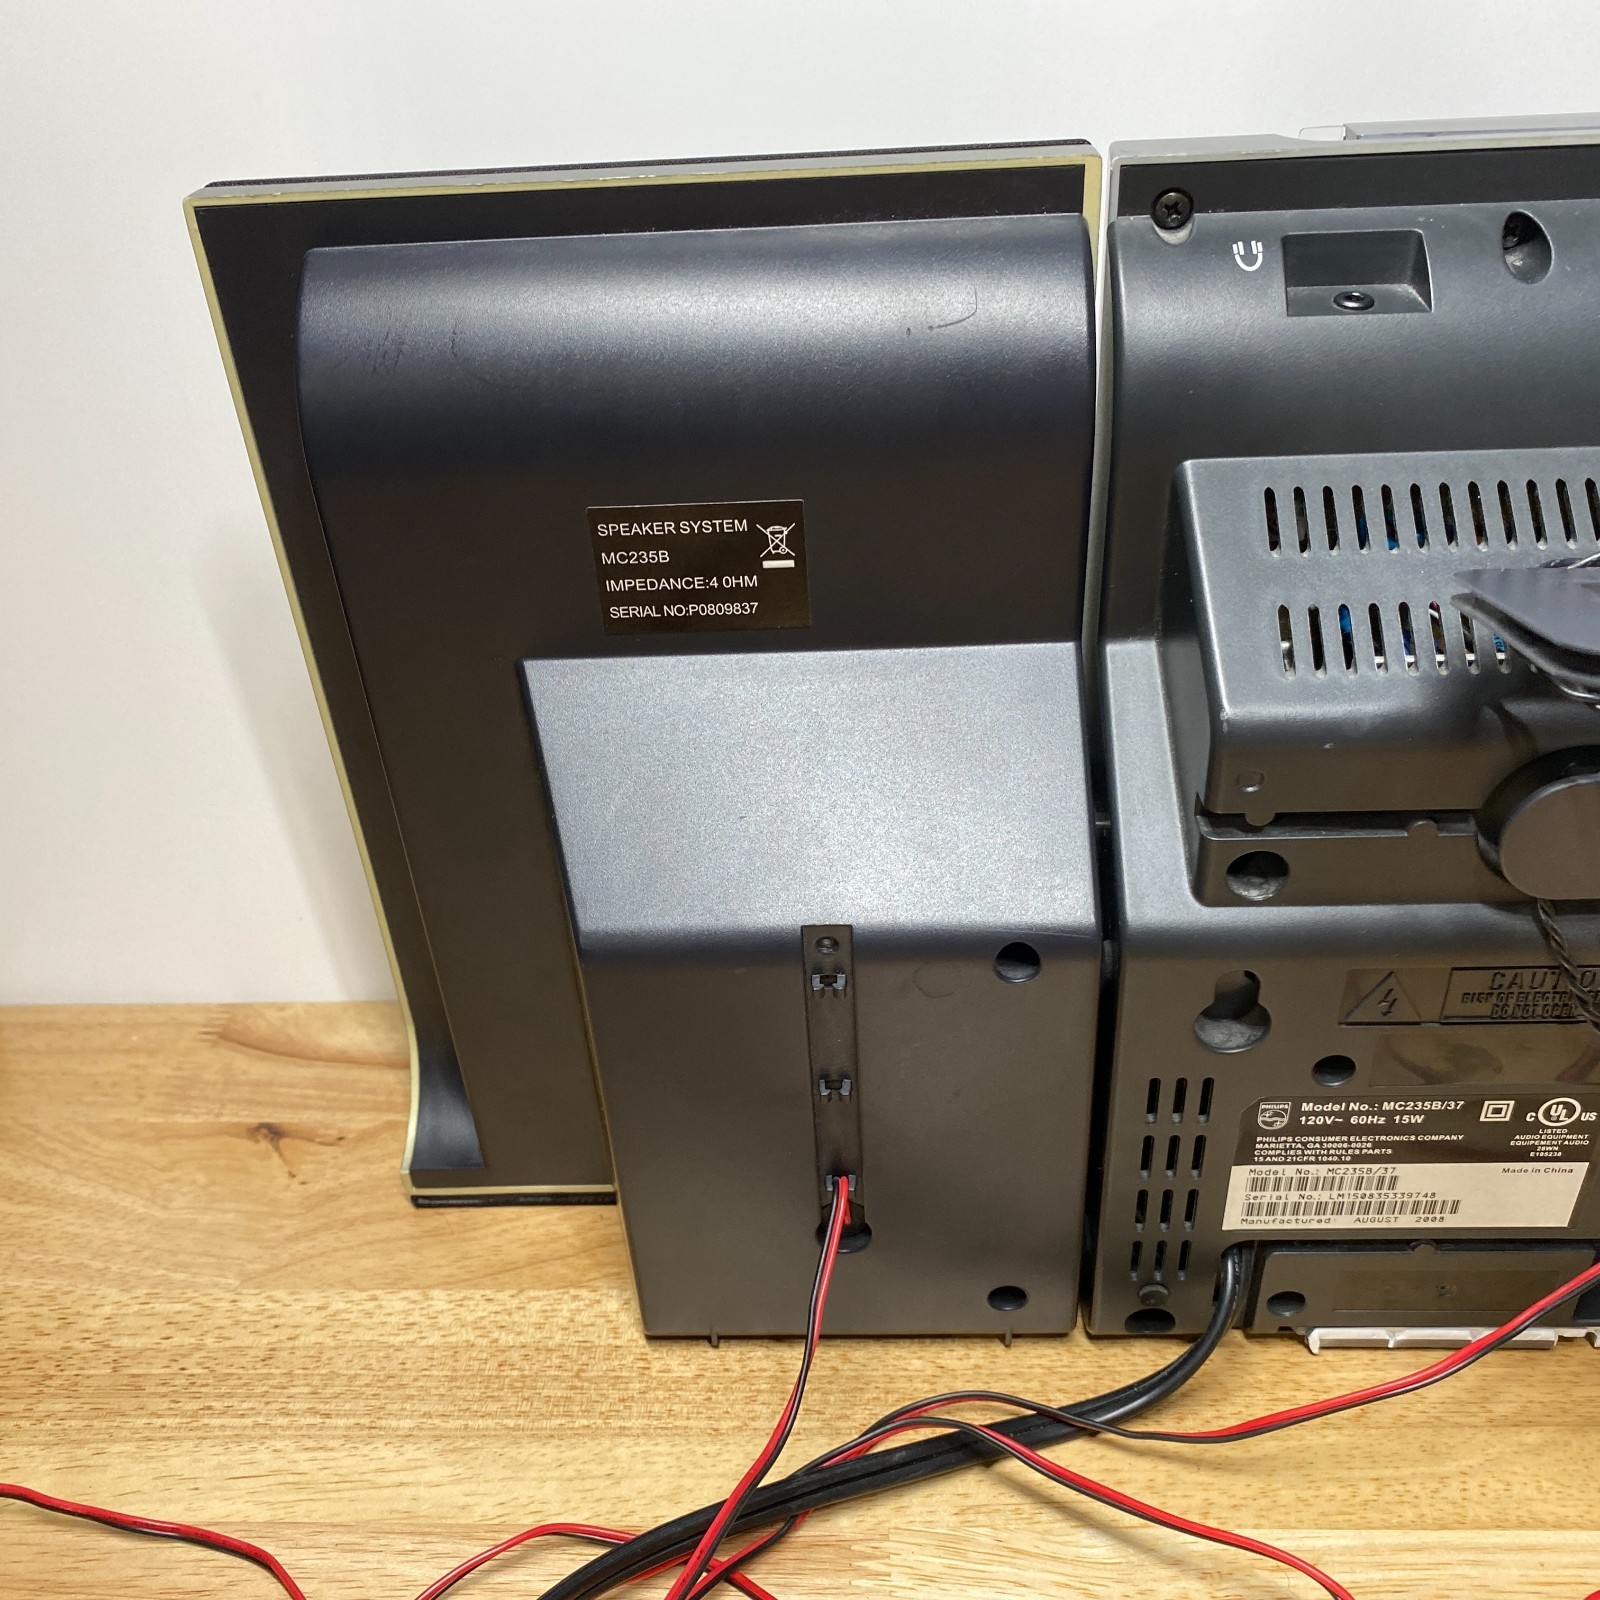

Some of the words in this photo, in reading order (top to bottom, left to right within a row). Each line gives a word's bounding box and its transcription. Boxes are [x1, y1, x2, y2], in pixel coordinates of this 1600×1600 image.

[597, 521, 676, 536] SPEAKER
[679, 519, 748, 534] SYSTEM
[601, 550, 669, 565] MC235B
[605, 576, 718, 592] IMPEDANCE:4
[610, 605, 661, 619] SERIAL
[663, 602, 758, 617] NO:P0809837
[1301, 1102, 1345, 1111] Model
[1348, 1102, 1379, 1111] No.:
[1382, 1101, 1464, 1111] MC235B/37
[1350, 1115, 1386, 1124] 60Hz
[1393, 1115, 1425, 1124] 15W
[1248, 1168, 1286, 1176] Model
[1326, 1167, 1397, 1175] MC235B/37
[1245, 1193, 1289, 1201] Serial
